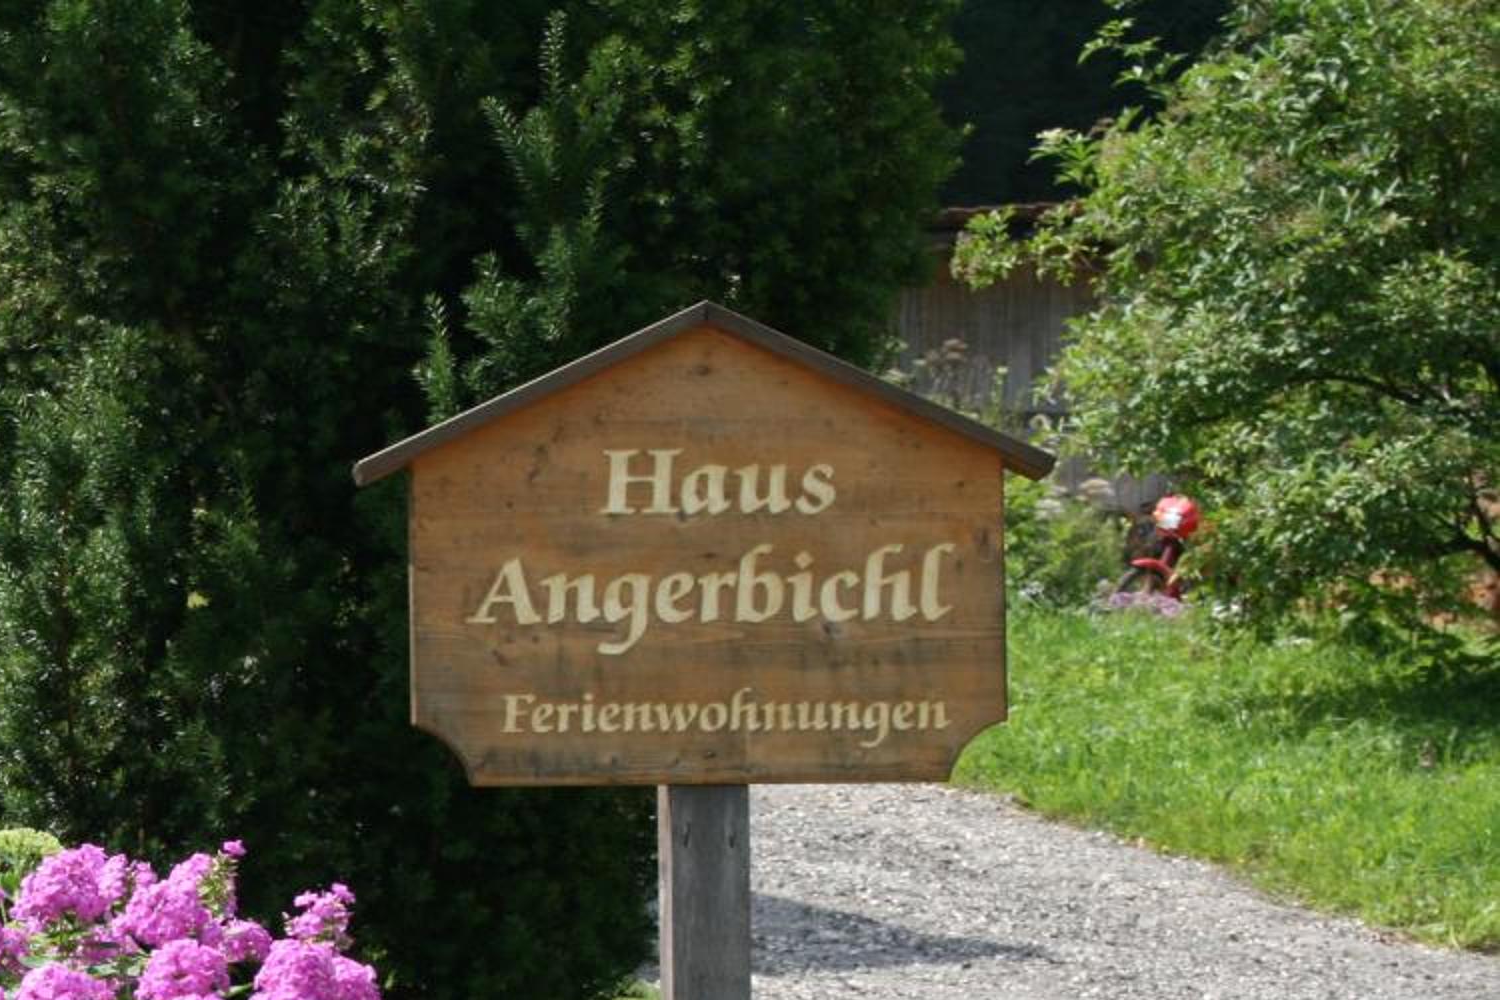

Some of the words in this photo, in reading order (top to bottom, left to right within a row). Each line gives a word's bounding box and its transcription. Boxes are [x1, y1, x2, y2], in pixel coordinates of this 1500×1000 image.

[600, 447, 837, 517] Haus
[466, 542, 957, 656] Angerbichl
[501, 685, 951, 749] Ferienwohnungen
